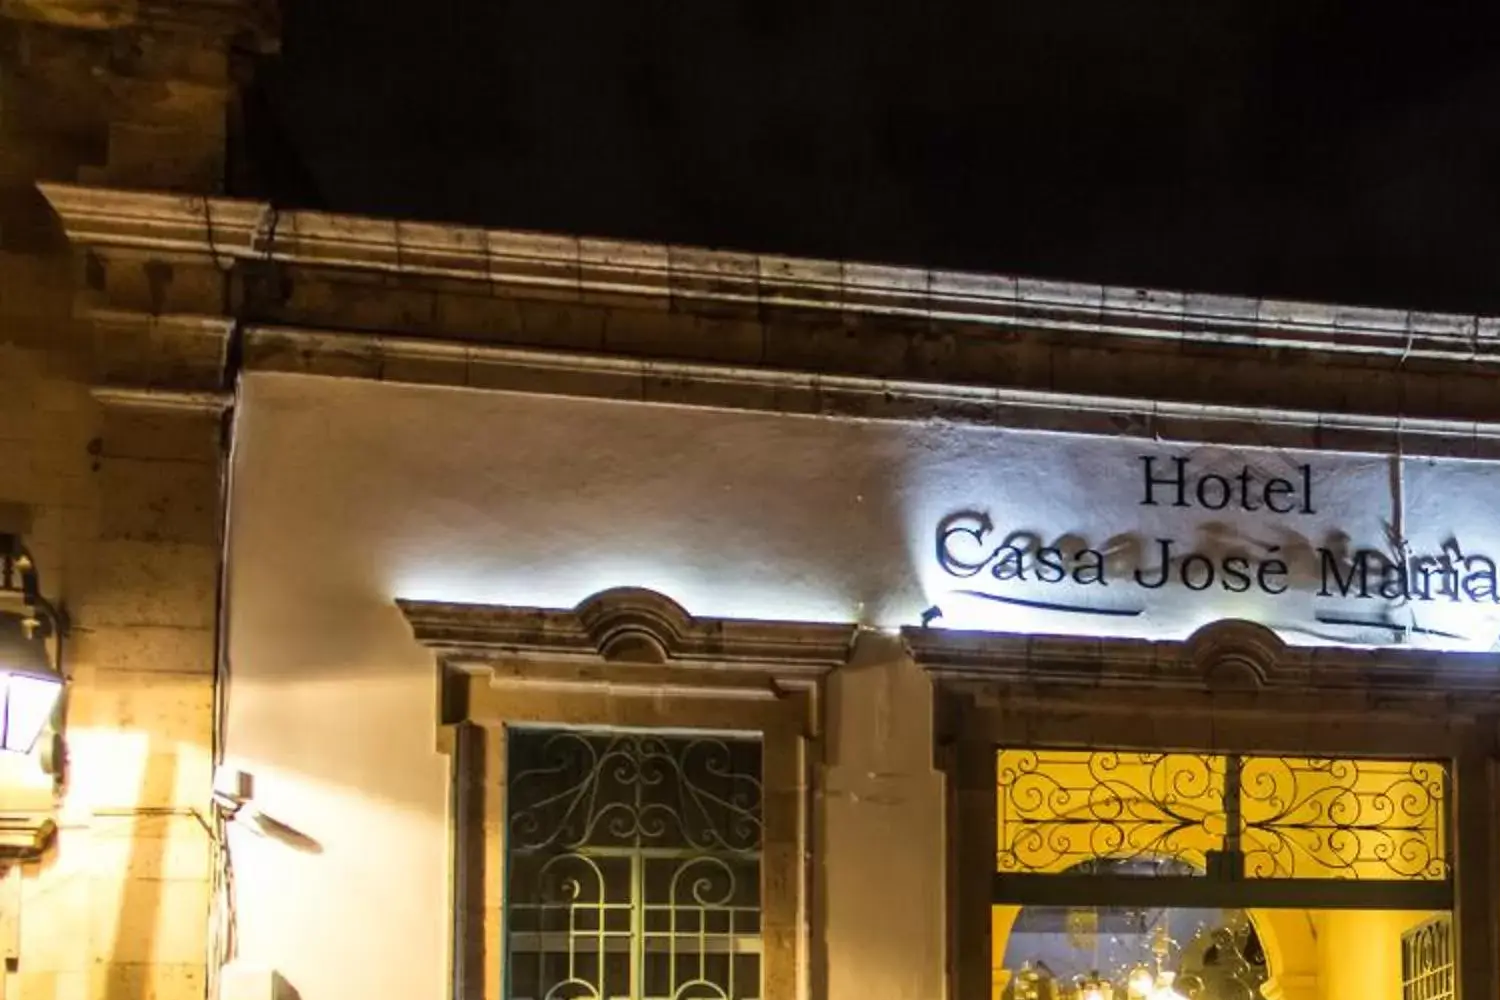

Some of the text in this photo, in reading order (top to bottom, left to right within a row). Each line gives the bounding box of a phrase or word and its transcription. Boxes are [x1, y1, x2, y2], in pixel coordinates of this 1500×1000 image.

[1138, 455, 1317, 515] Hotel
[937, 514, 1108, 586] Casa
[1133, 538, 1288, 595] José
